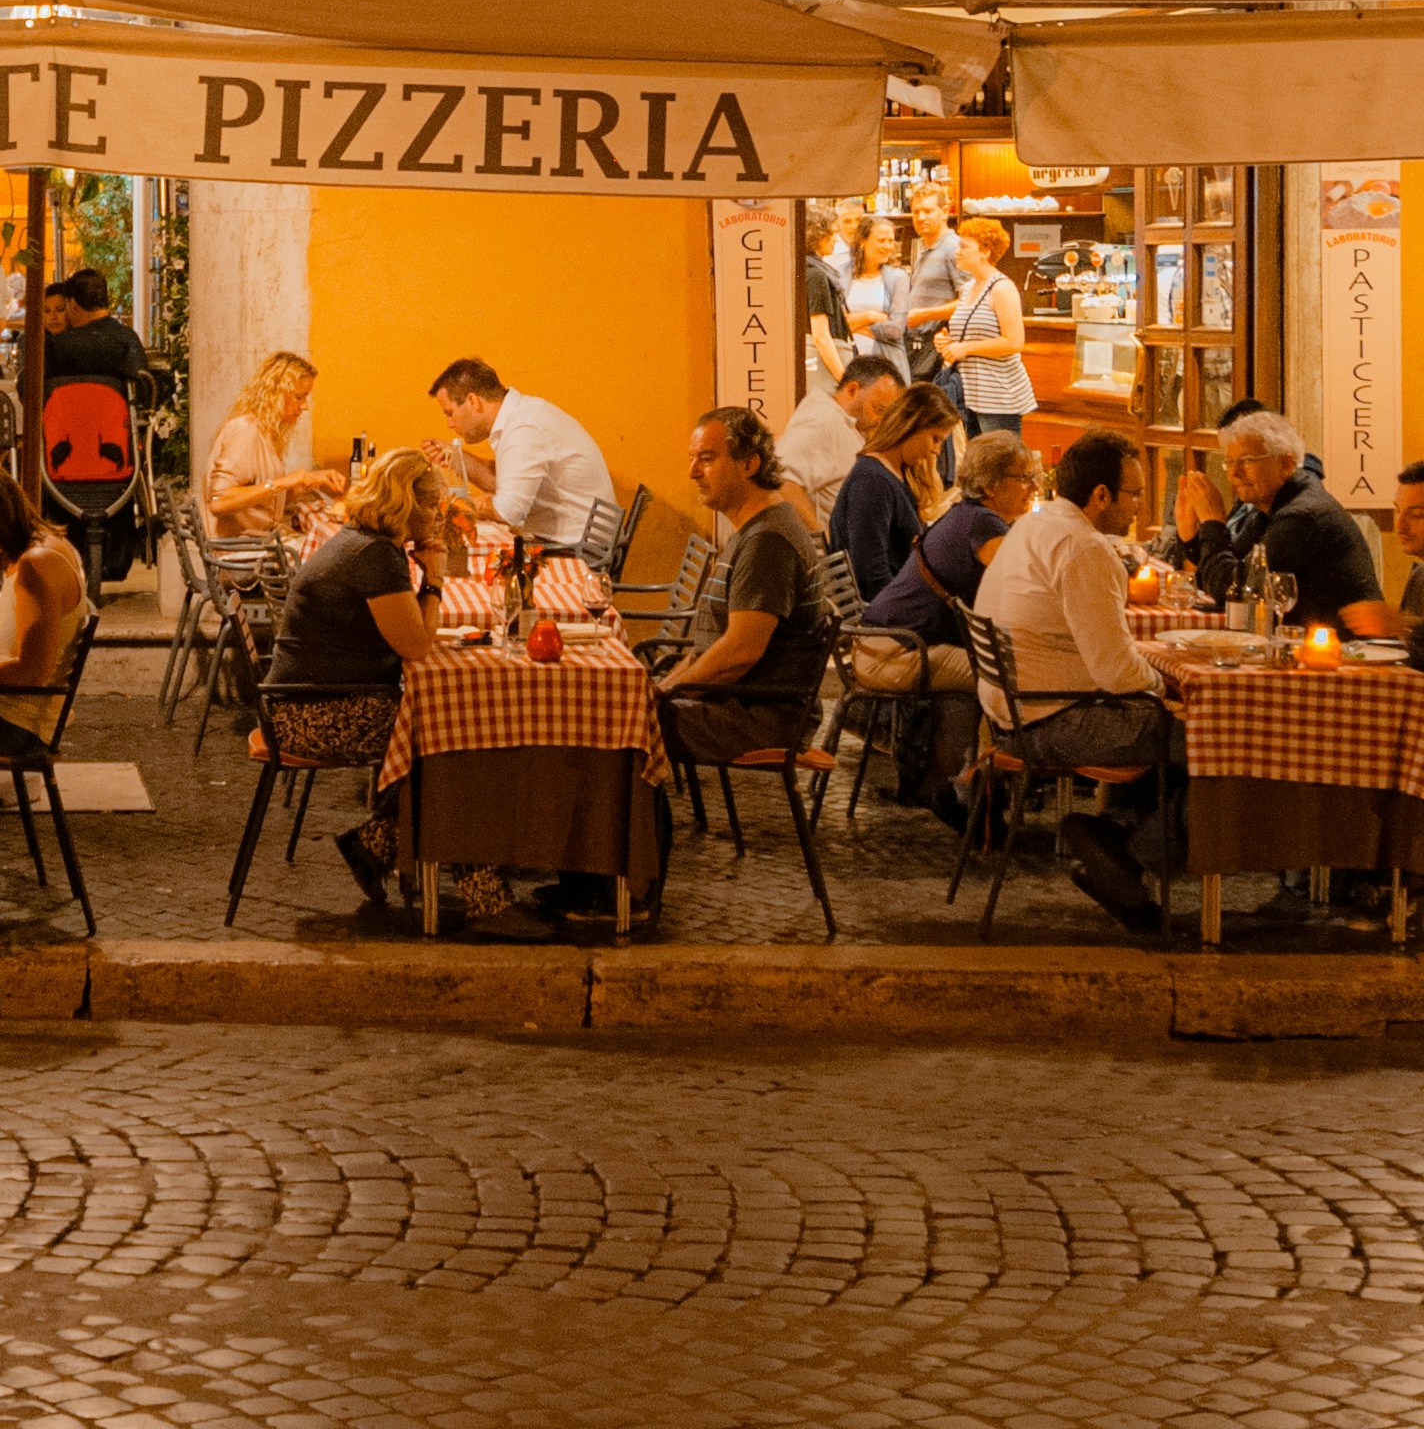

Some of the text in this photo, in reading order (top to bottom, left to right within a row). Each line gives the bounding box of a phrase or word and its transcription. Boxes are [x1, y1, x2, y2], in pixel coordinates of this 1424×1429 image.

[193, 74, 771, 183] PIZZERIA
[719, 210, 788, 229] LABORATORIO
[1326, 232, 1398, 249] LABORATORIO
[741, 228, 769, 420] GELATER
[1348, 248, 1375, 496] PASTICCERIA
